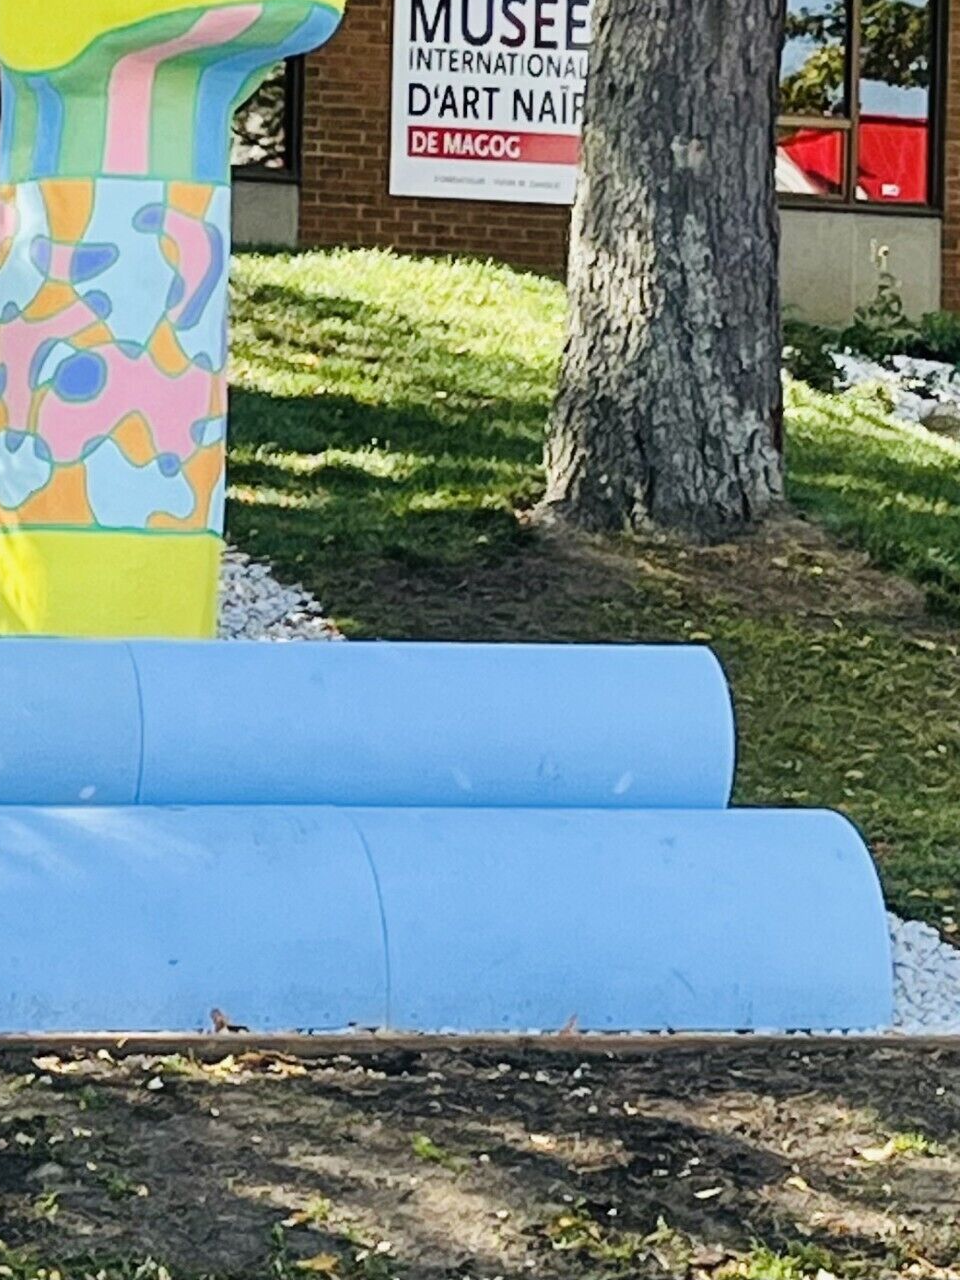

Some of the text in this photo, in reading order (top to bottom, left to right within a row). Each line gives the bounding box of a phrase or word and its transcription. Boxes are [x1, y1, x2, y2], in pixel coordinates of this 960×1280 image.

[408, 48, 587, 79] INTERNATIONAL
[408, 83, 500, 121] D'ART
[411, 130, 521, 158] DE MAGOG
